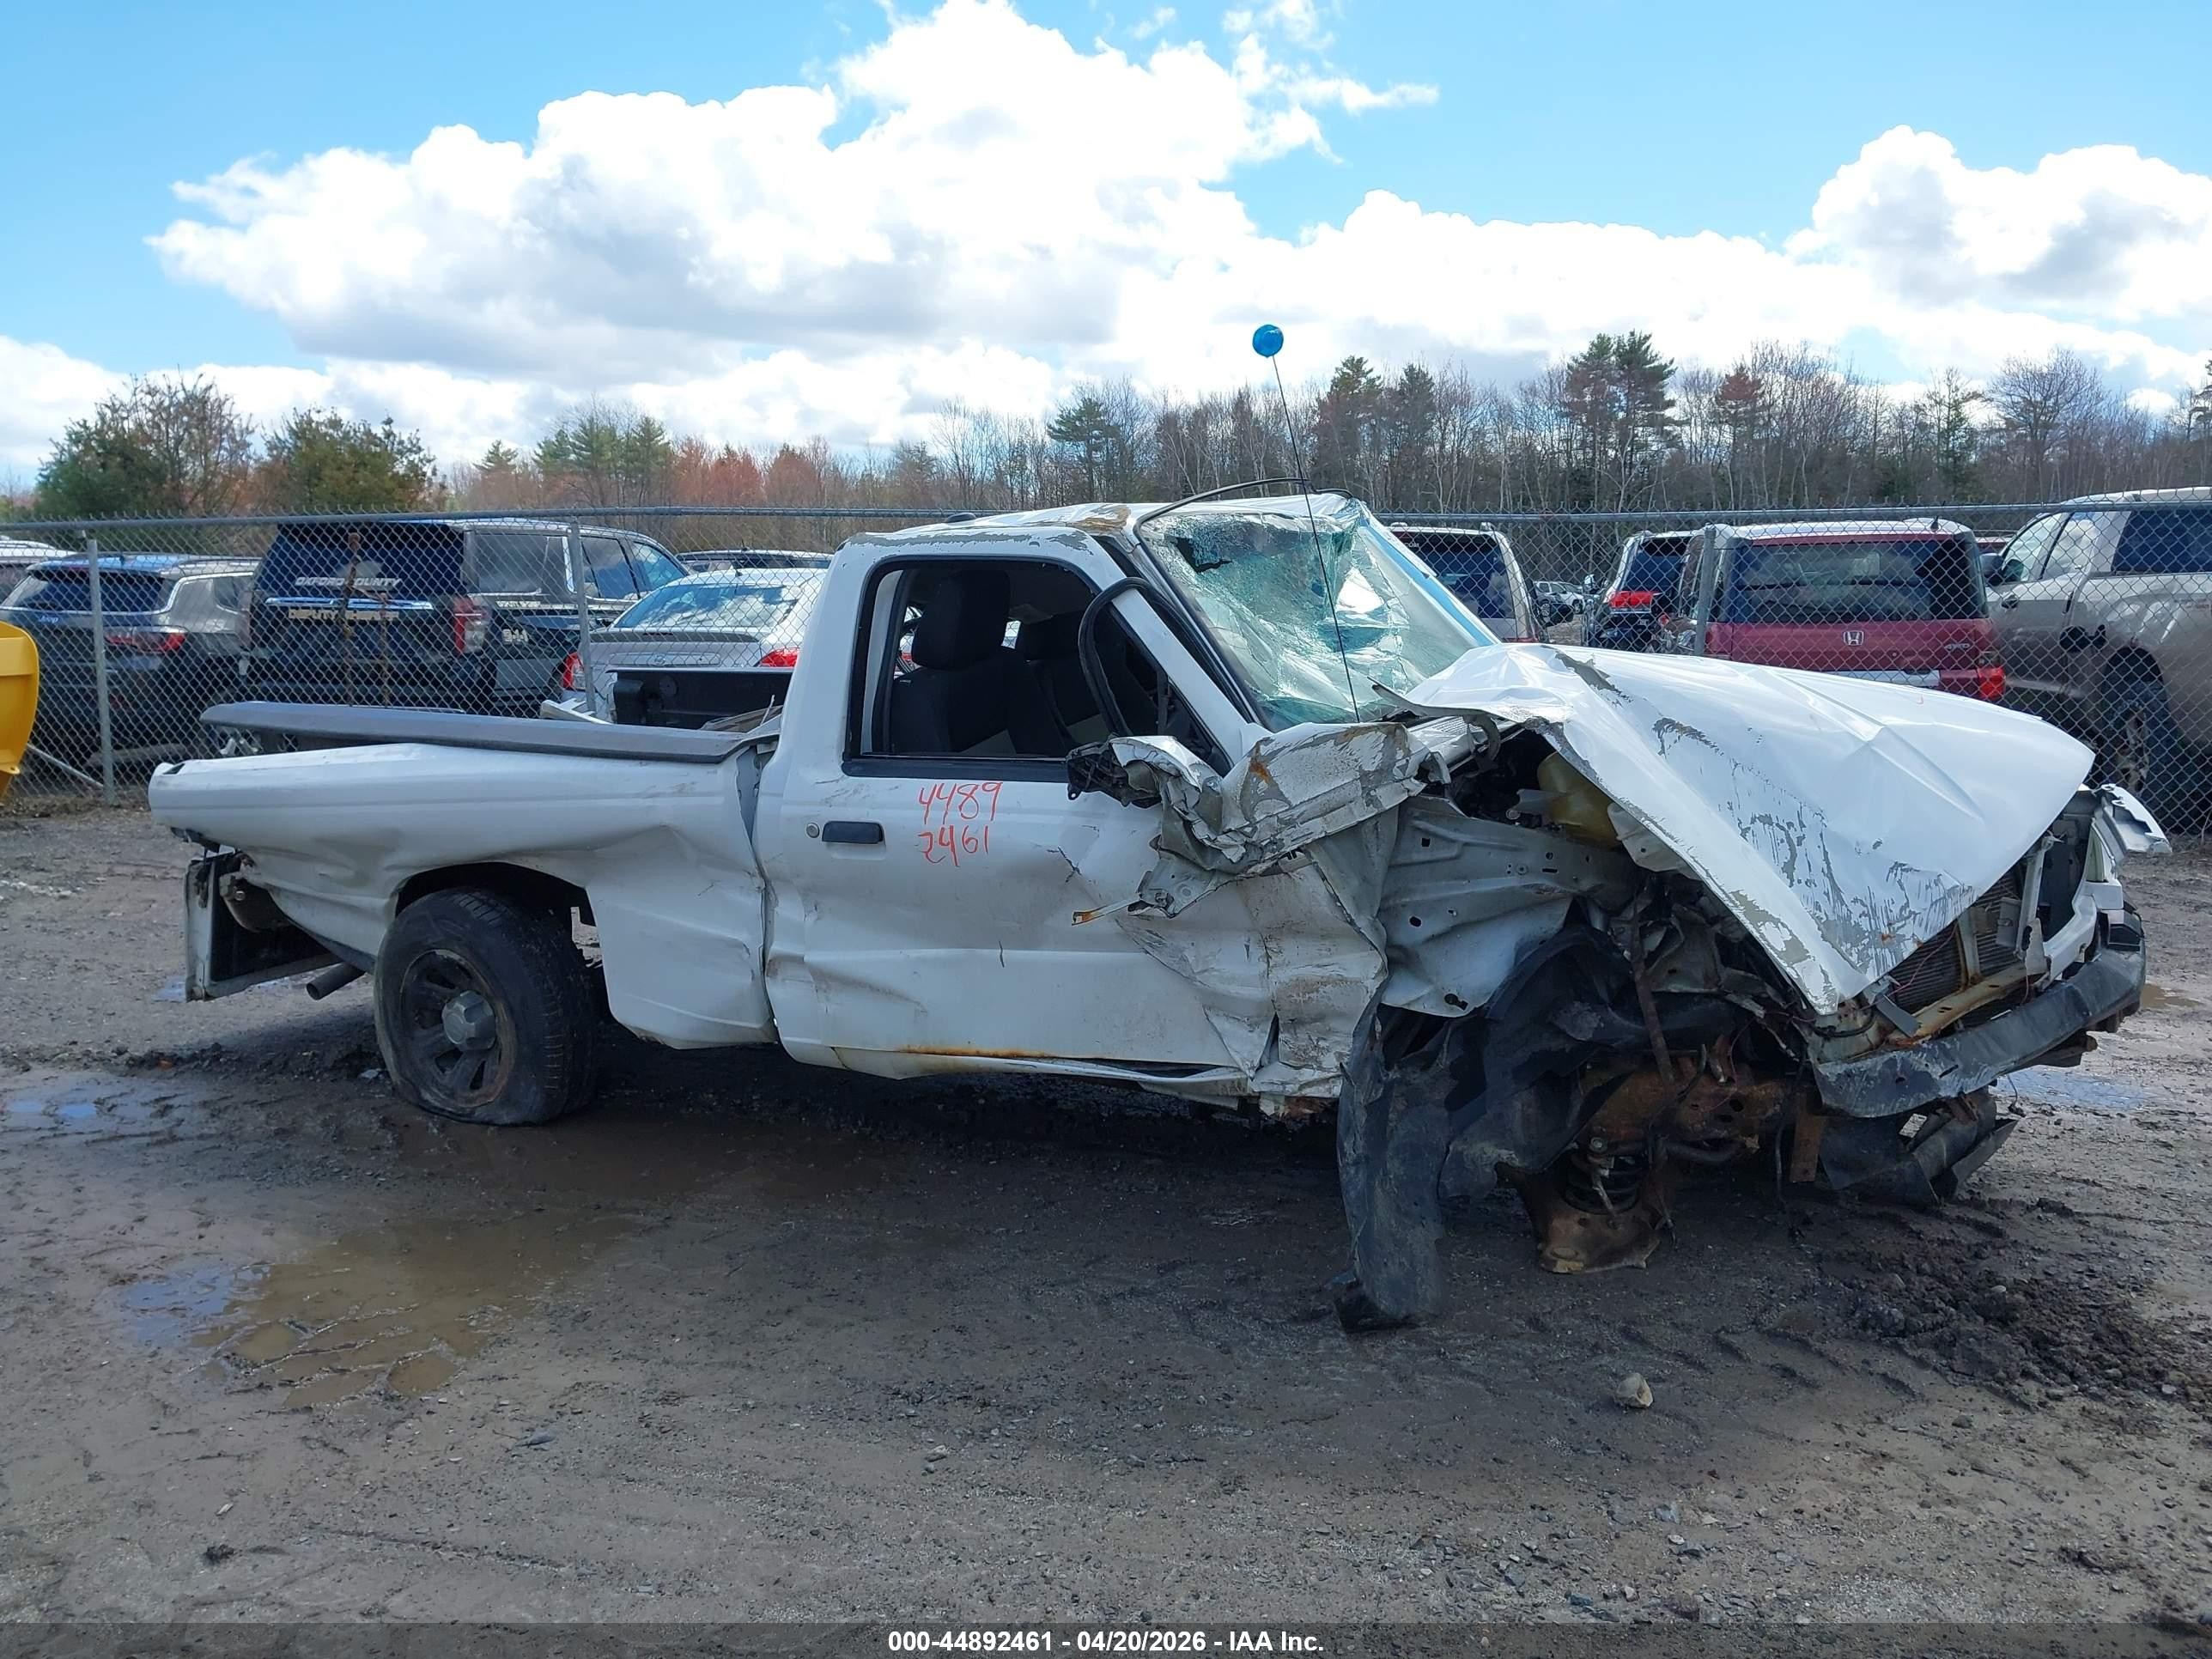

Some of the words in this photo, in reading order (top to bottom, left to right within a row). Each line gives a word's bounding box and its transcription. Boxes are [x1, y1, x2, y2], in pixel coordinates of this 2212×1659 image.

[295, 576, 345, 586] OXFORD
[347, 577, 403, 587] OUNTY
[919, 781, 1003, 824] 4489
[917, 825, 990, 867] 2461
